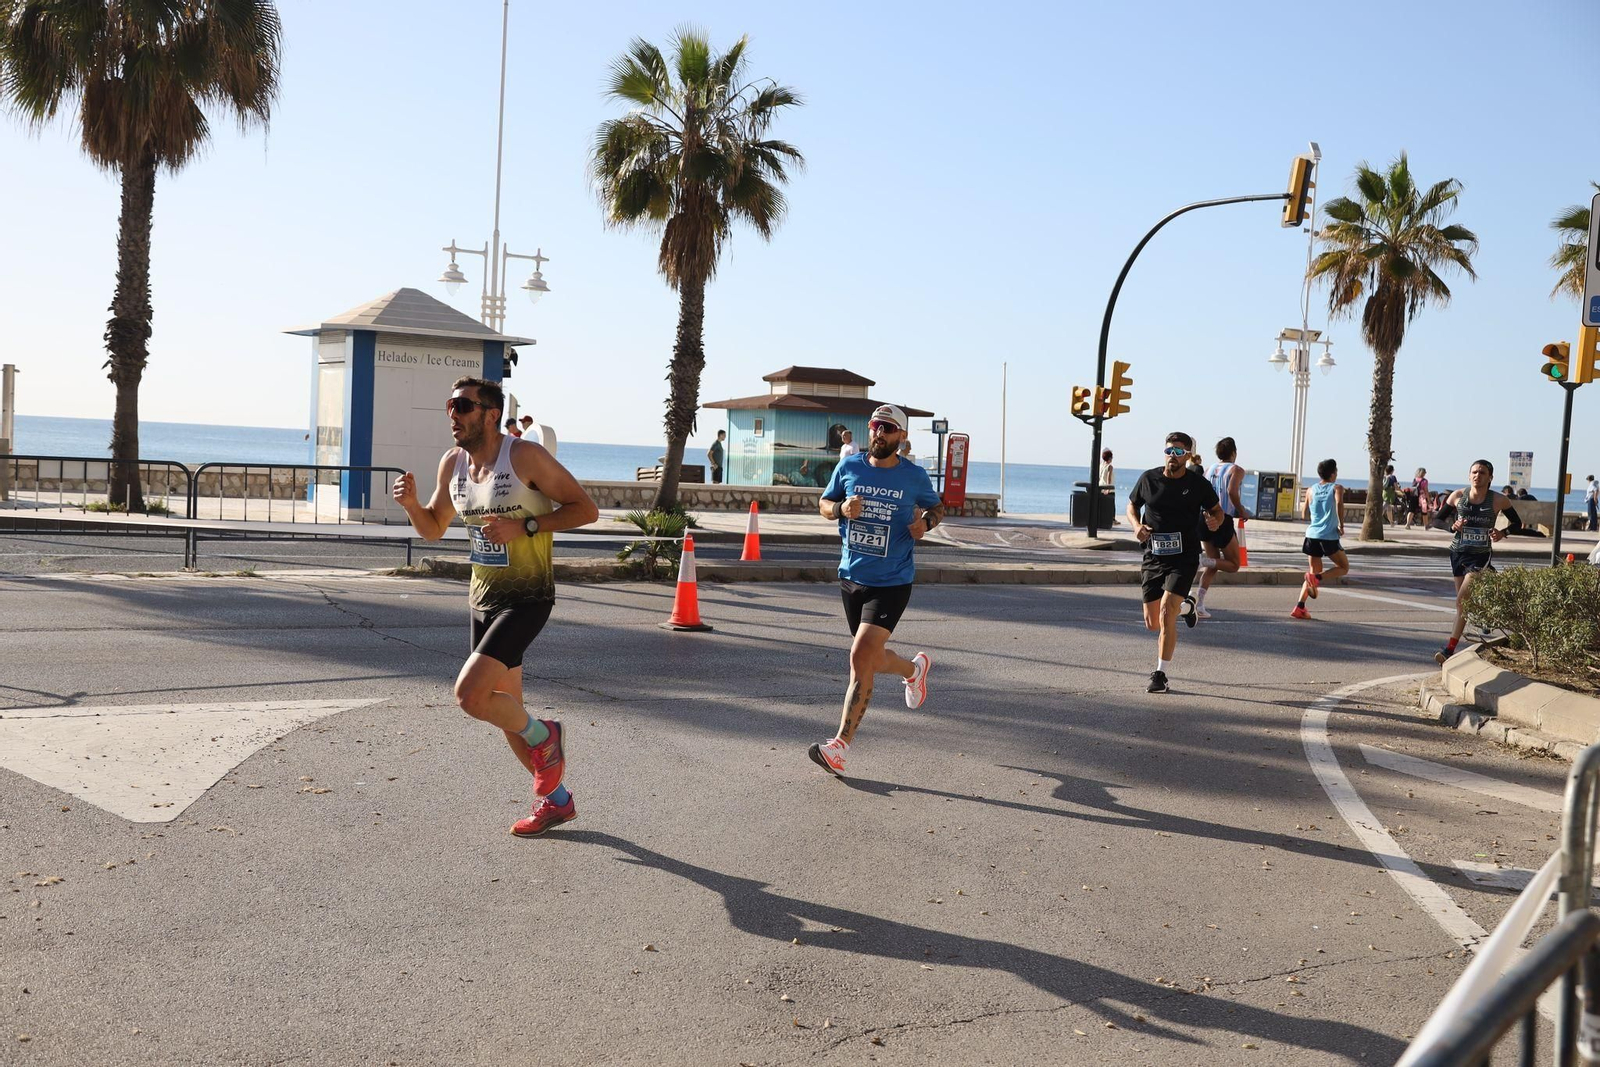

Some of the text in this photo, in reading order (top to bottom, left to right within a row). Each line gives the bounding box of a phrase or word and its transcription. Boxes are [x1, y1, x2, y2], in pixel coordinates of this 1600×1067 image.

[378, 350, 418, 364] Helados
[427, 354, 442, 366] Ice
[444, 355, 480, 369] Creams
[854, 485, 903, 499] mayoral
[490, 504, 522, 514] MÁLAGA
[860, 500, 899, 511] UNNING,
[859, 512, 892, 521] RIENDS
[852, 532, 882, 545] 1721
[1464, 533, 1486, 541] 1501
